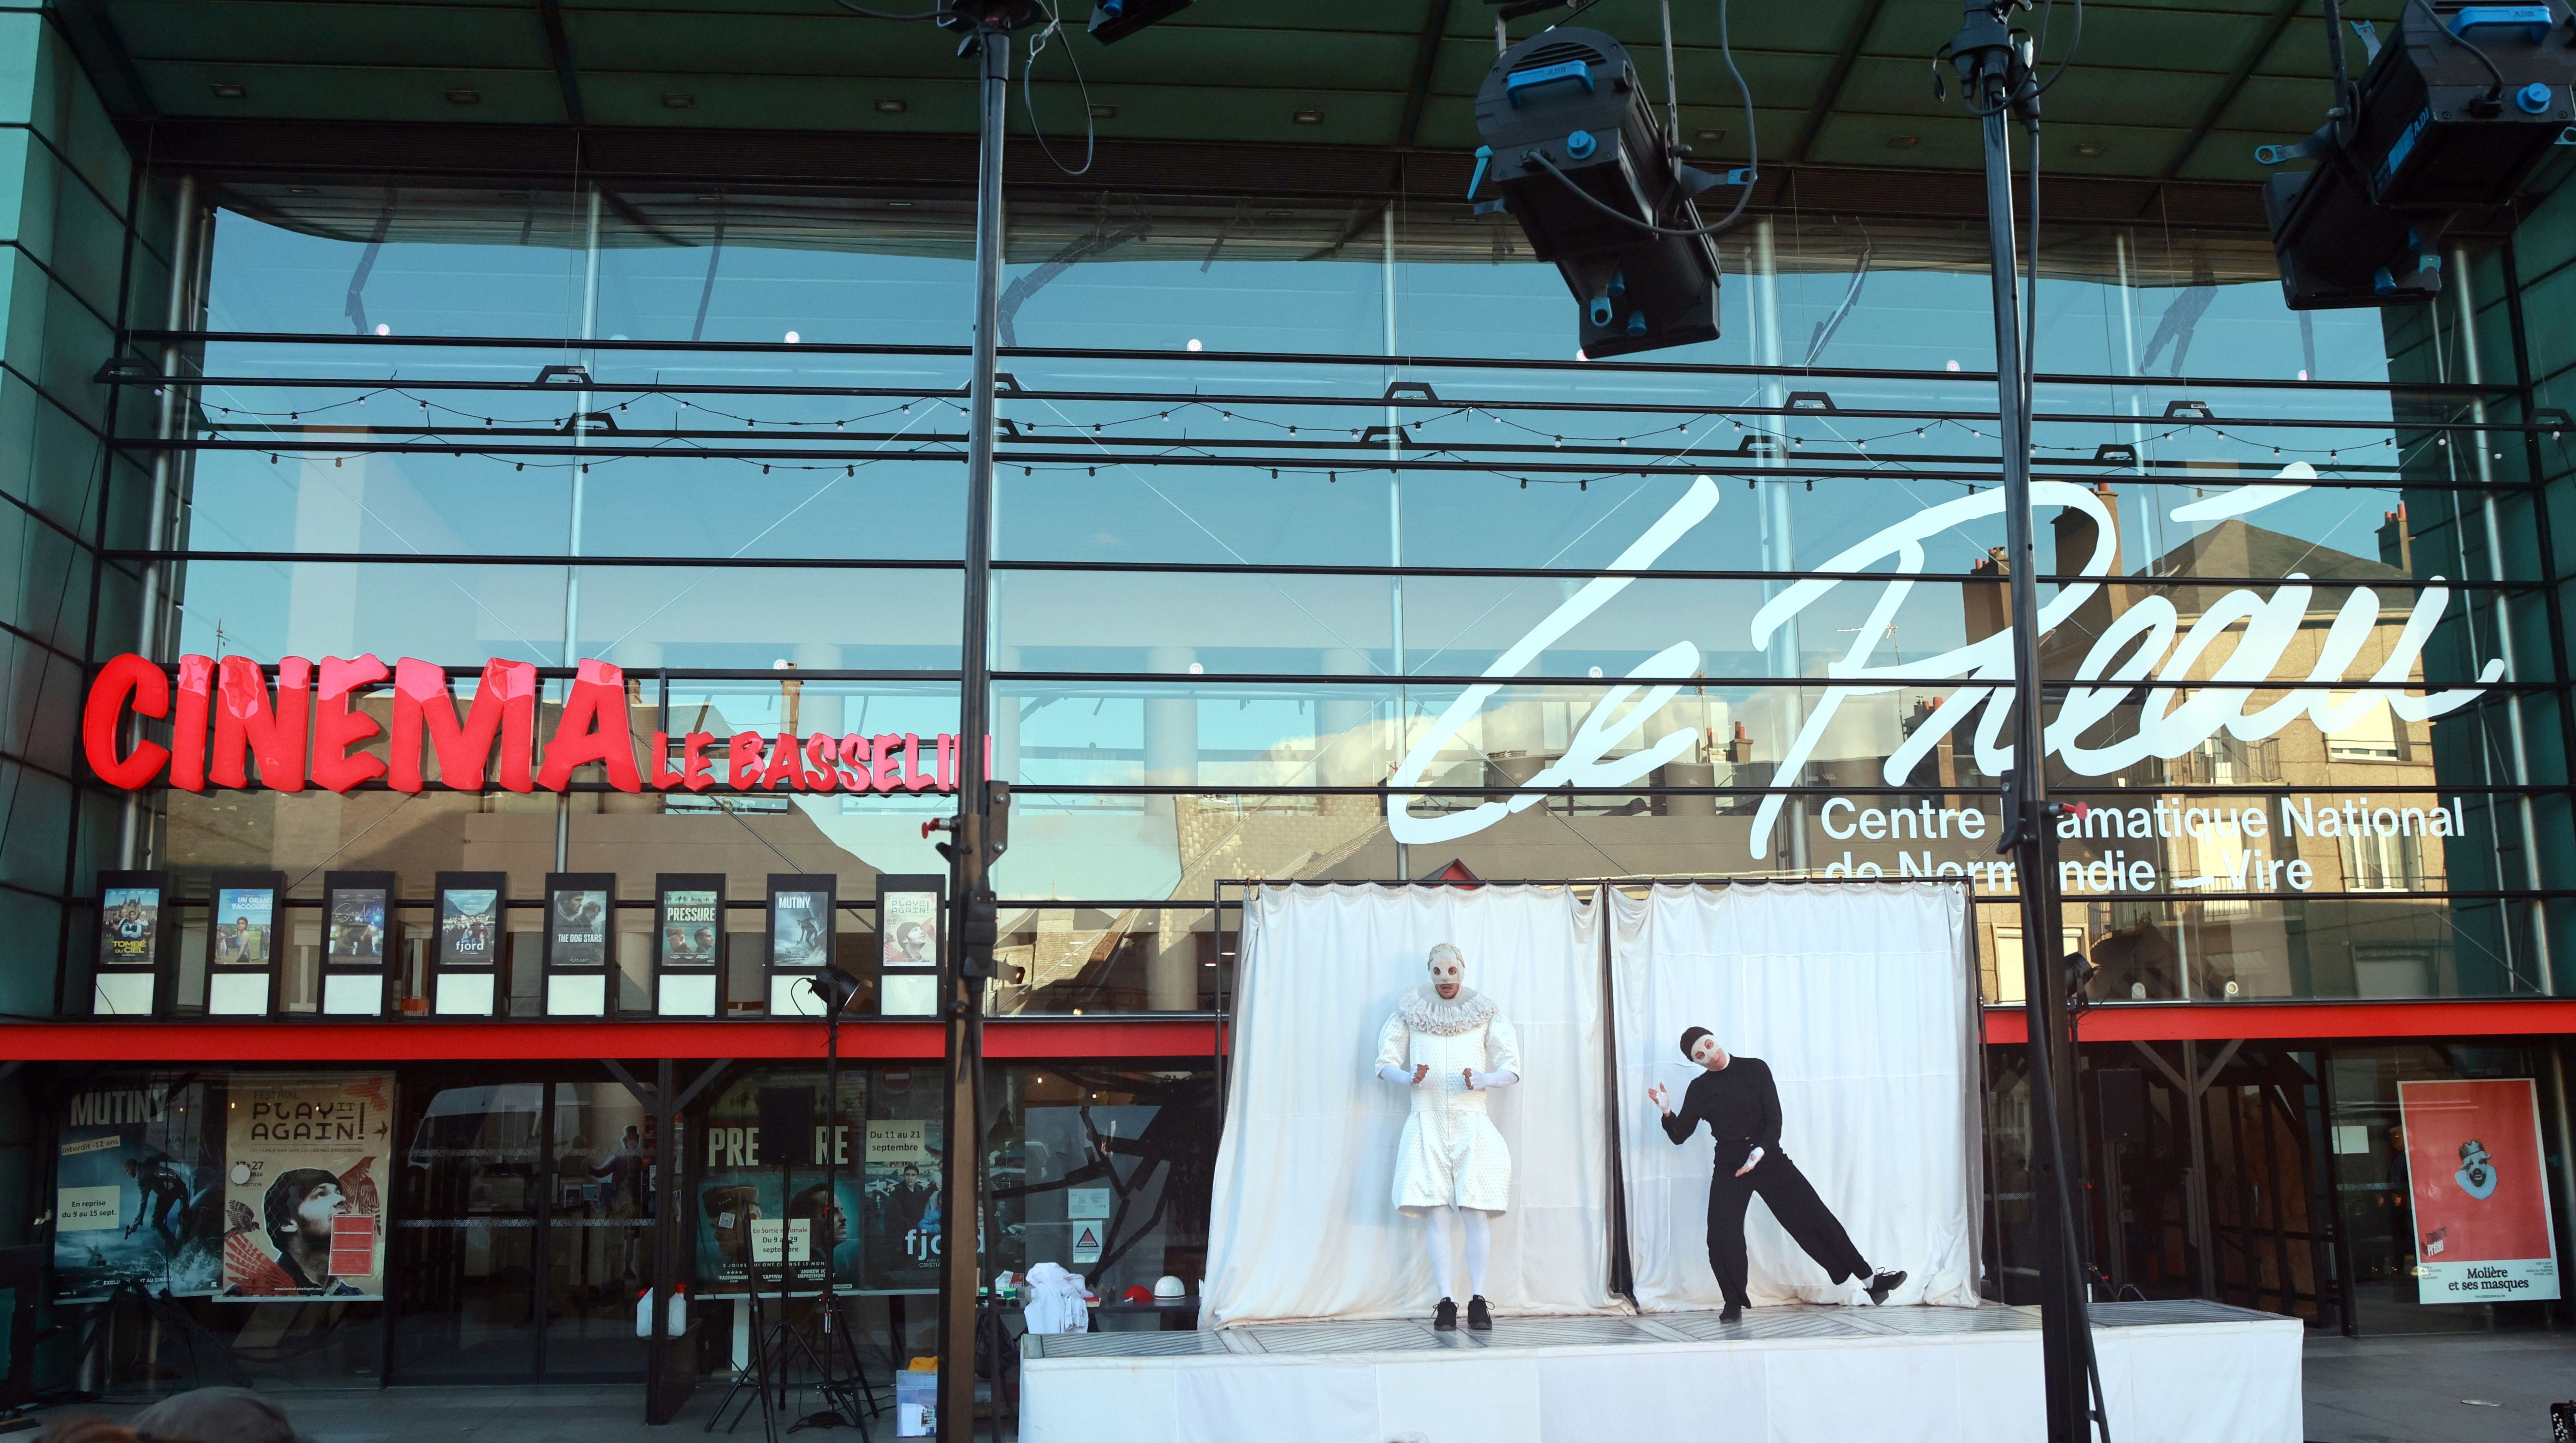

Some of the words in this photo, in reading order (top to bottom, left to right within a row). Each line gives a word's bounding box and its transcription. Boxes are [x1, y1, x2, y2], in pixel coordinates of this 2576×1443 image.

[1388, 474, 1719, 844] Le
[83, 653, 641, 793] CINEMA
[651, 730, 716, 792] LE
[1821, 797, 1985, 840] Centre
[2000, 797, 2268, 850] amatique
[2283, 797, 2465, 838] National
[1899, 850, 2156, 891] Normndie
[2224, 848, 2313, 891] Vire
[779, 897, 811, 908] MUTINY
[667, 908, 715, 921] PRESSURE
[558, 934, 569, 942] THE
[570, 934, 582, 942] DOG
[584, 934, 602, 943] STARS
[456, 941, 483, 956] fjord
[255, 1091, 299, 1100] FESTIVAL
[71, 1089, 168, 1126] MUTINY
[253, 1102, 334, 1119] PLAY
[709, 1126, 848, 1166] PRERE
[872, 1144, 918, 1152] septembre
[905, 1227, 986, 1260] fjod
[2467, 1266, 2508, 1279] Molière
[2448, 1281, 2459, 1290] et
[2462, 1281, 2478, 1290] ses
[2481, 1279, 2529, 1292] masques
